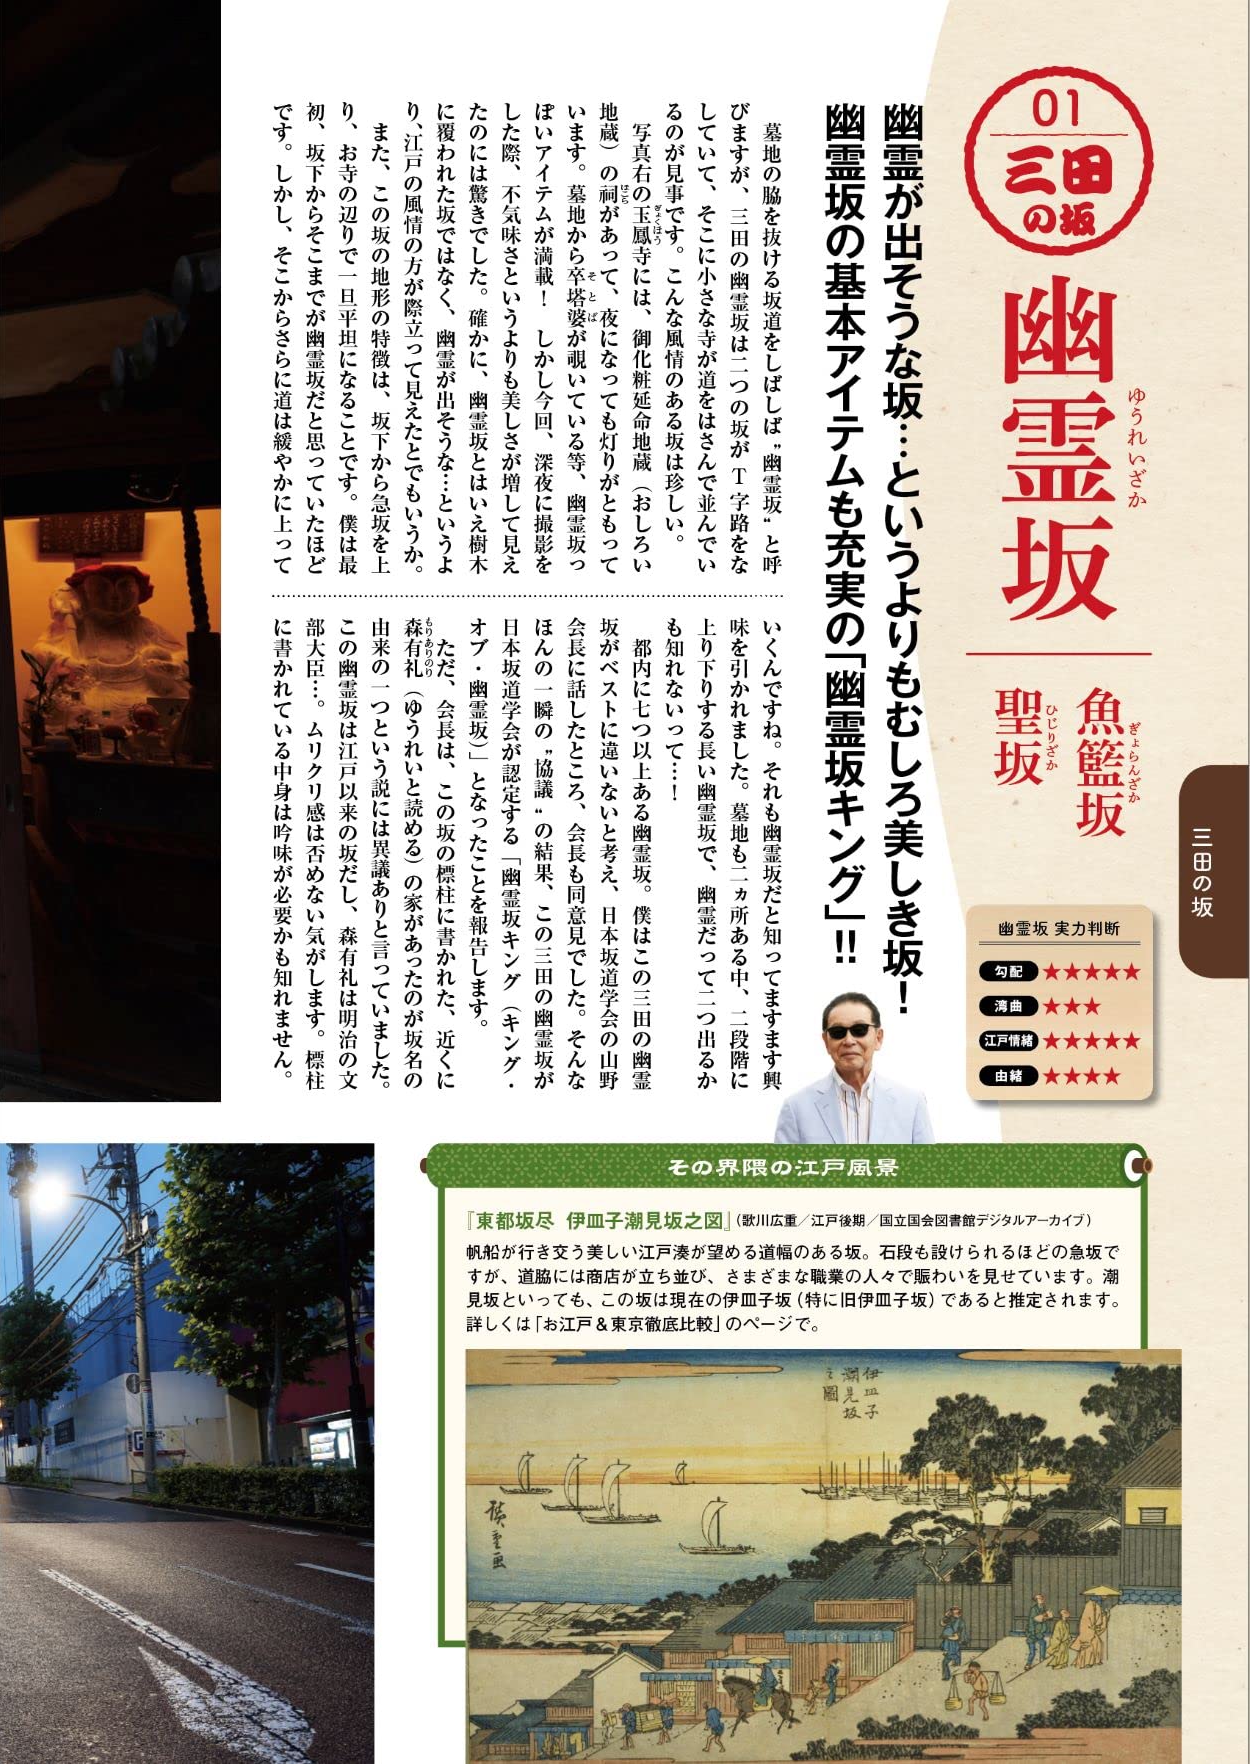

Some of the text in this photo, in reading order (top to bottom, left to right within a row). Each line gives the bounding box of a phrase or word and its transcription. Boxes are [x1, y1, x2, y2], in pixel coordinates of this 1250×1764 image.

[1005, 145, 1112, 195] 三田
[1023, 202, 1096, 236] の坂
[1033, 89, 1078, 127] 01
[273, 104, 292, 573] です。しかし、そこからさらに道は緩やかに上って
[306, 103, 325, 574] 初、坂下からそこまでが幽霊坂だと思っていたほど
[338, 102, 358, 574] り、お寺の辺りで一旦平坦になることです。僕は最
[371, 123, 391, 573] また、この坂の地形の特徴は、坂下から急坂を上
[404, 102, 423, 572] り、江戸の風情の方が際立って見えたとでもいうか。
[469, 103, 488, 574] たのには驚きでした。確かに、幽霊坂とはいえ樹木
[502, 103, 521, 573] した際、不気味さというよりも美しさが増して見え
[665, 104, 684, 541] るのが見事です。こんな風情のある坂は珍しい。
[698, 103, 717, 572] していて、そこに小さな寺が道をはさんで並んでい
[1002, 275, 1117, 621] 幽霊坂
[1128, 388, 1147, 507] ゆうれいざか
[424, 617, 434, 677] もりありのり
[994, 687, 1043, 785] 聖坂
[1046, 705, 1058, 770] ひじりざか
[1076, 687, 1125, 837] 魚籃坂
[1129, 722, 1141, 803] ぎょらんざか
[273, 619, 293, 1077] に書かれている中身は吟味が必要かも知れません。
[339, 620, 358, 1089] この幽霊坂は江戸以来の坂だし、森有礼は明治の文
[371, 618, 390, 1088] 由来の一つという説には異議ありと言っていました。
[437, 639, 455, 1089] ただ、会長は、この坂の標柱に書かれた、近くに
[568, 618, 586, 1089] 会長に話したところ、会長も同意見でした。そんな
[600, 618, 619, 1090] 坂がベストに違いないと考え、日本坂道学会の山野
[632, 639, 651, 1089] 都内に七つ以上ある幽霊坂。僕はこの三田の幽霊
[697, 619, 717, 1089] 上り下りする長い幽霊坂で、幽霊だって二つ出るか
[763, 621, 782, 1090] いくんですね。それも幽霊坂だと知ってますます興
[985, 1034, 1033, 1047] 江戸情緒
[995, 965, 1022, 978] 勾配
[995, 1000, 1022, 1012] 湾曲
[999, 921, 1120, 936] 幽霊坂 実力判断
[1192, 829, 1213, 917] 三田の坂
[668, 1158, 900, 1177] その界隈の江戸風景
[996, 1069, 1022, 1082] 由緒
[862, 1367, 884, 1419] 伊皿子
